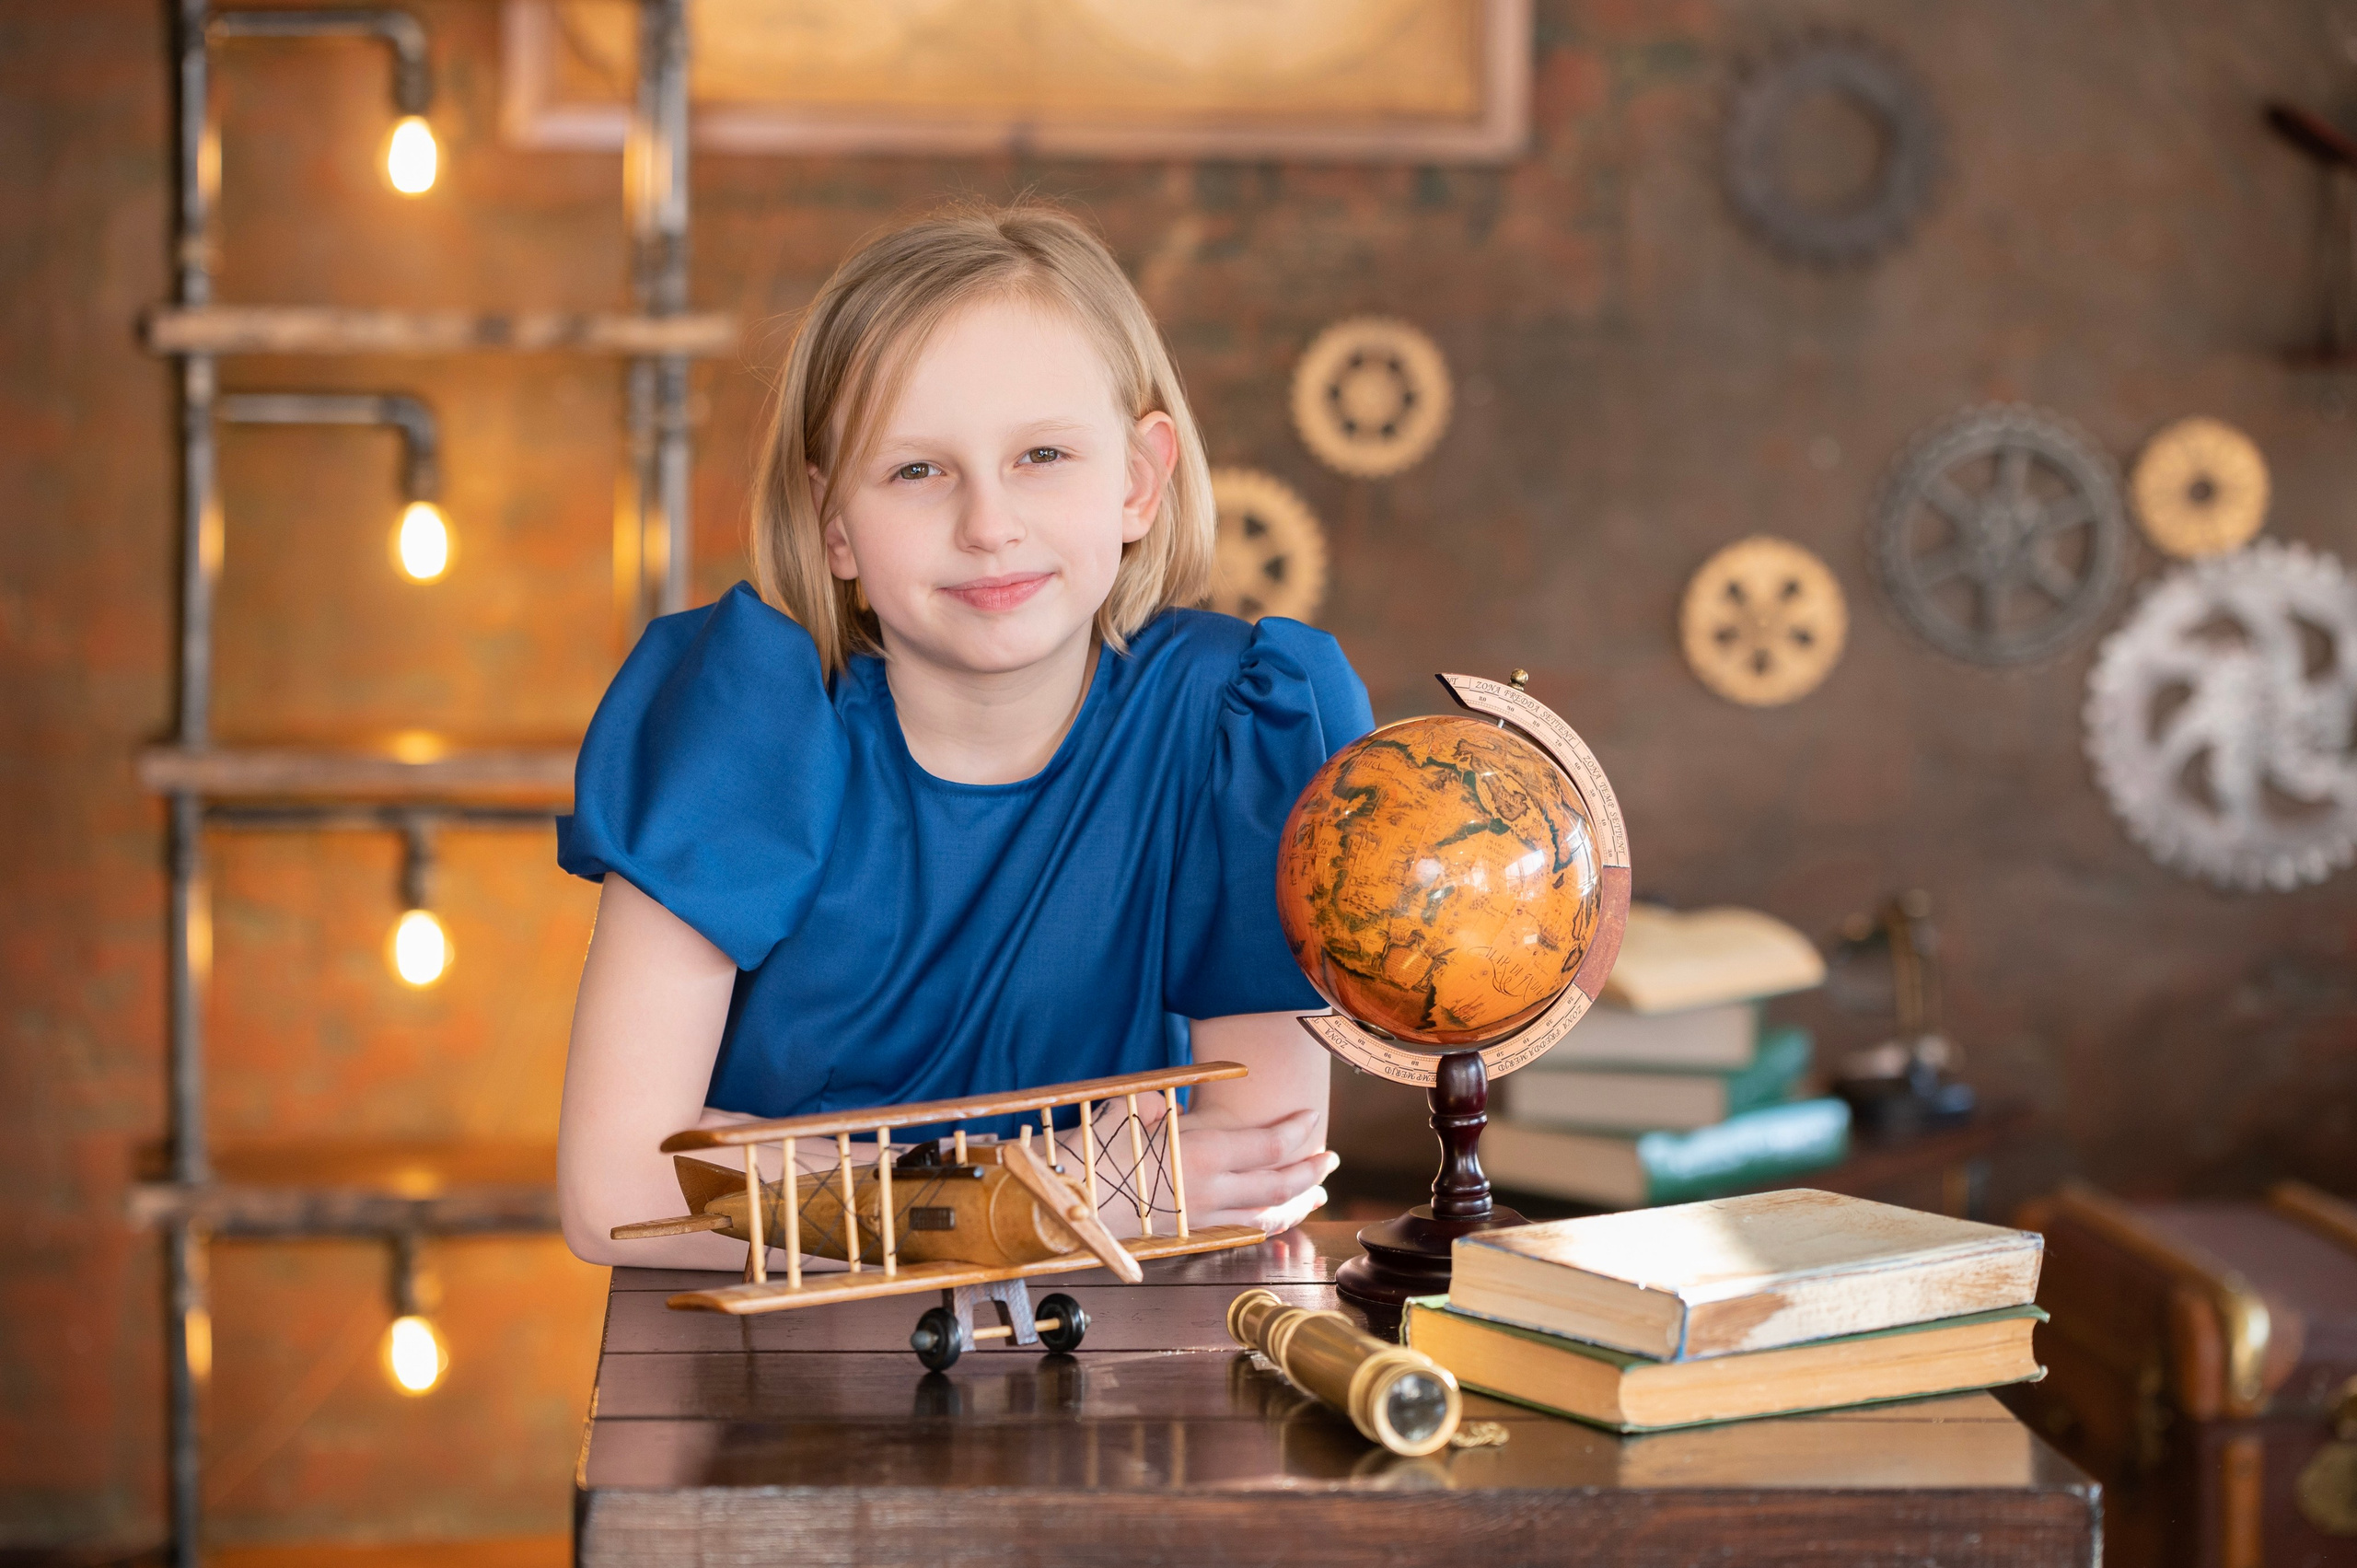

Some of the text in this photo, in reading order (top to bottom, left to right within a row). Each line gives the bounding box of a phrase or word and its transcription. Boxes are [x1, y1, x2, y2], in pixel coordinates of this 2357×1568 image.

[1475, 680, 1576, 742] ZONA FREDDA SETTENT
[1554, 739, 1562, 748] 70
[1583, 755, 1626, 855] ZONA TEMP SETTENT
[1562, 1005, 1583, 1029] ZONA
[1324, 1028, 1348, 1050] ZONA
[1528, 1028, 1562, 1056] FREDDA
